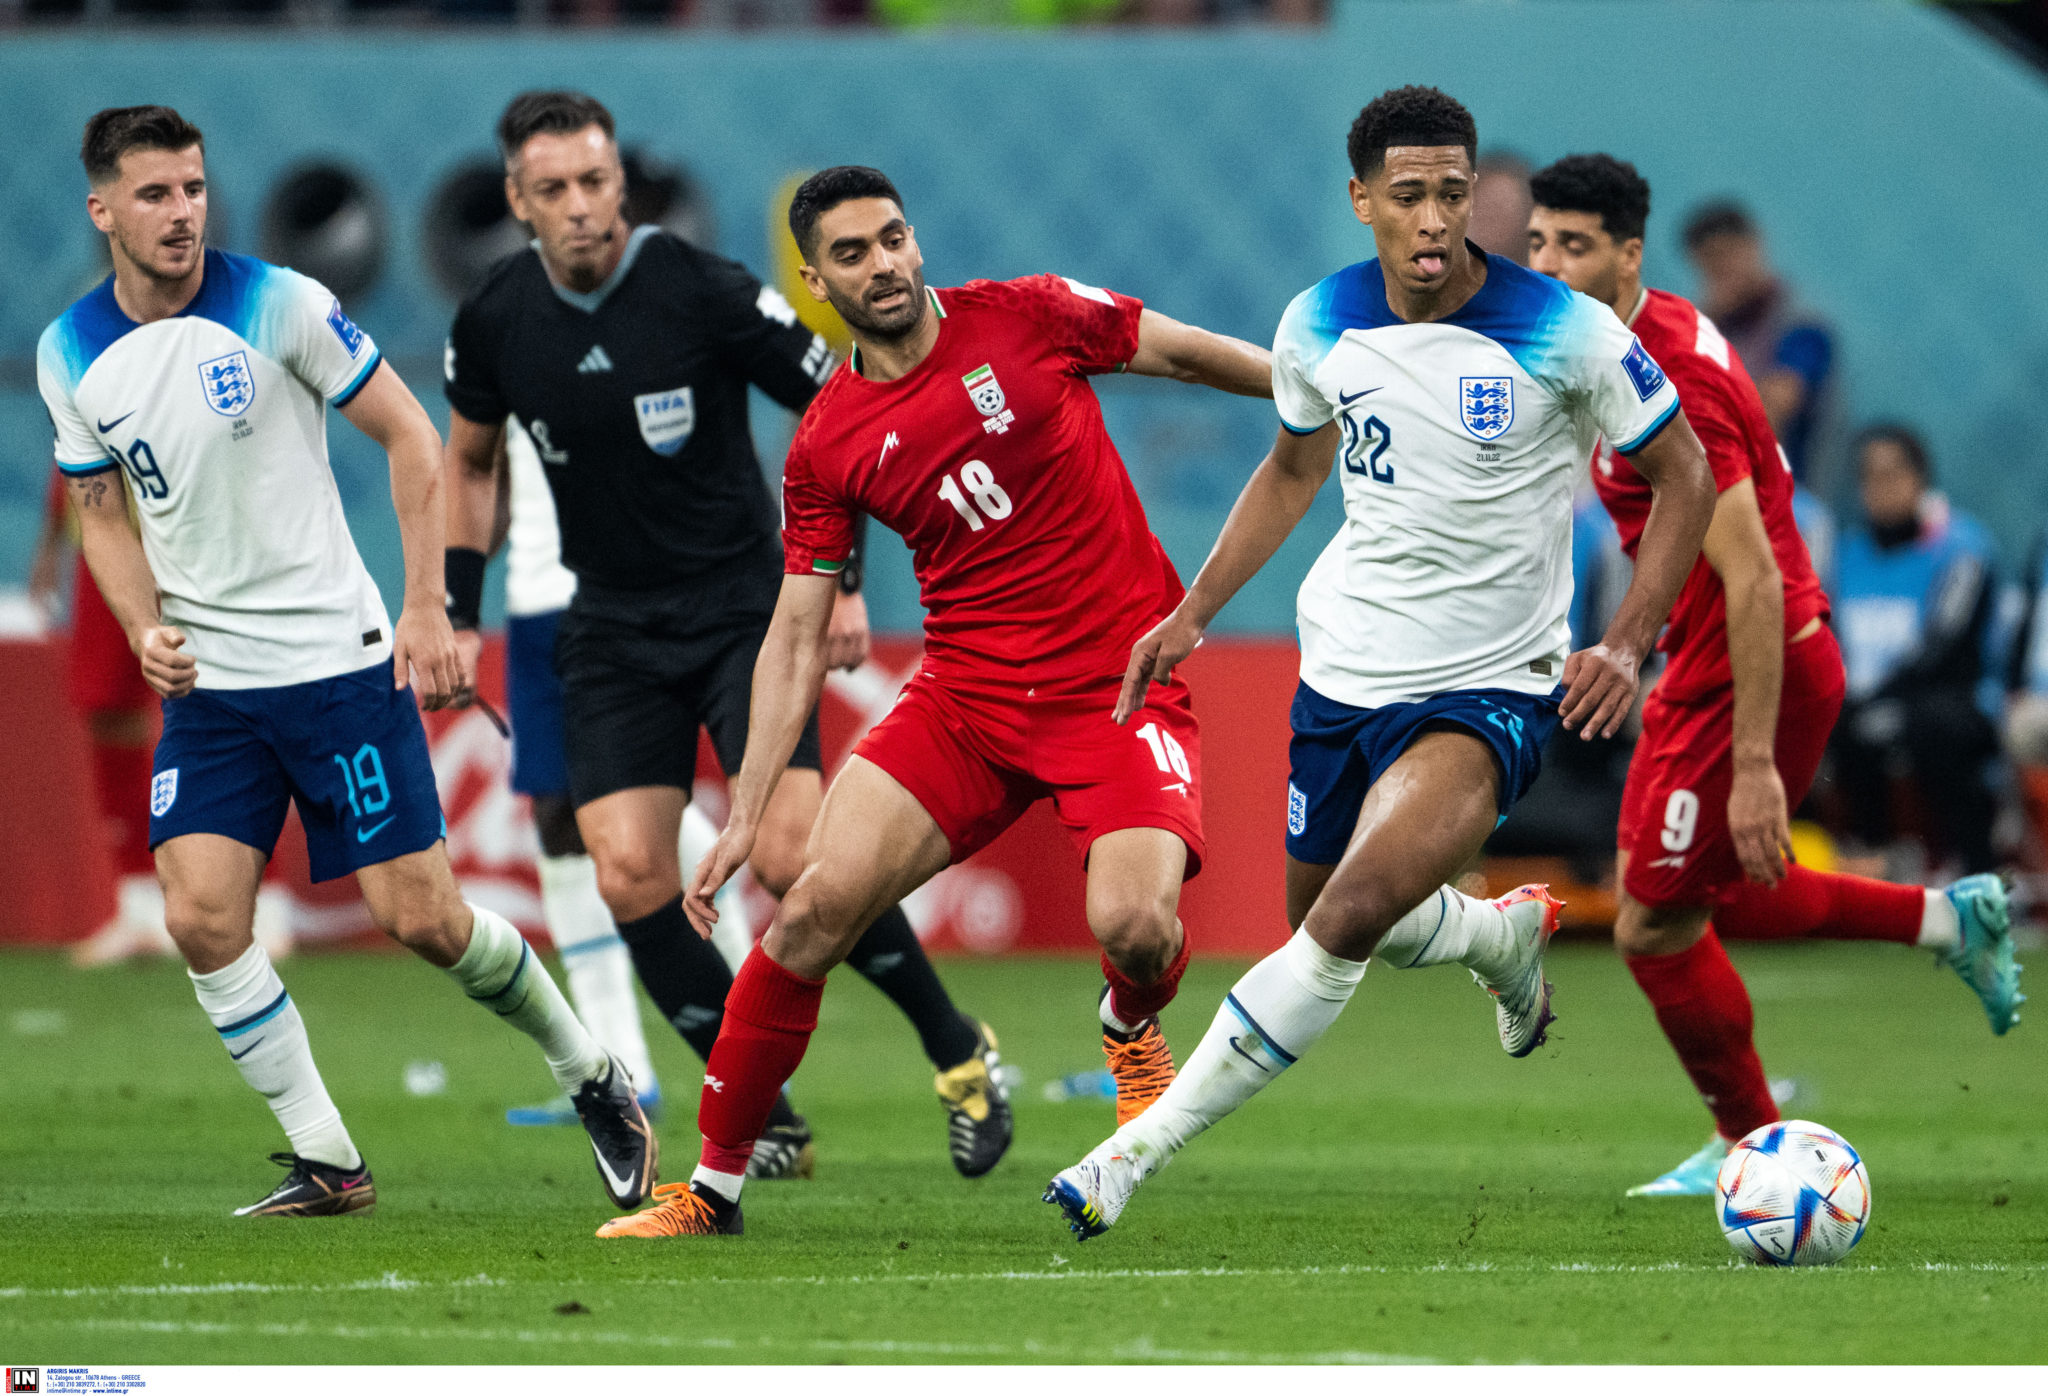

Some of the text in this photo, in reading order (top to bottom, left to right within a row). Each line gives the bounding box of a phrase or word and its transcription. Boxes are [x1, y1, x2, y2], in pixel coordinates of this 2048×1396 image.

[642, 396, 686, 415] FIFA
[108, 438, 169, 499] 19
[1342, 410, 1394, 484] 22
[1476, 453, 1501, 462] 21.11.22
[1480, 443, 1496, 451] IRAN
[937, 459, 1013, 532] 18
[334, 743, 391, 817] 19
[1135, 722, 1192, 784] 18
[1661, 788, 1699, 853] 9
